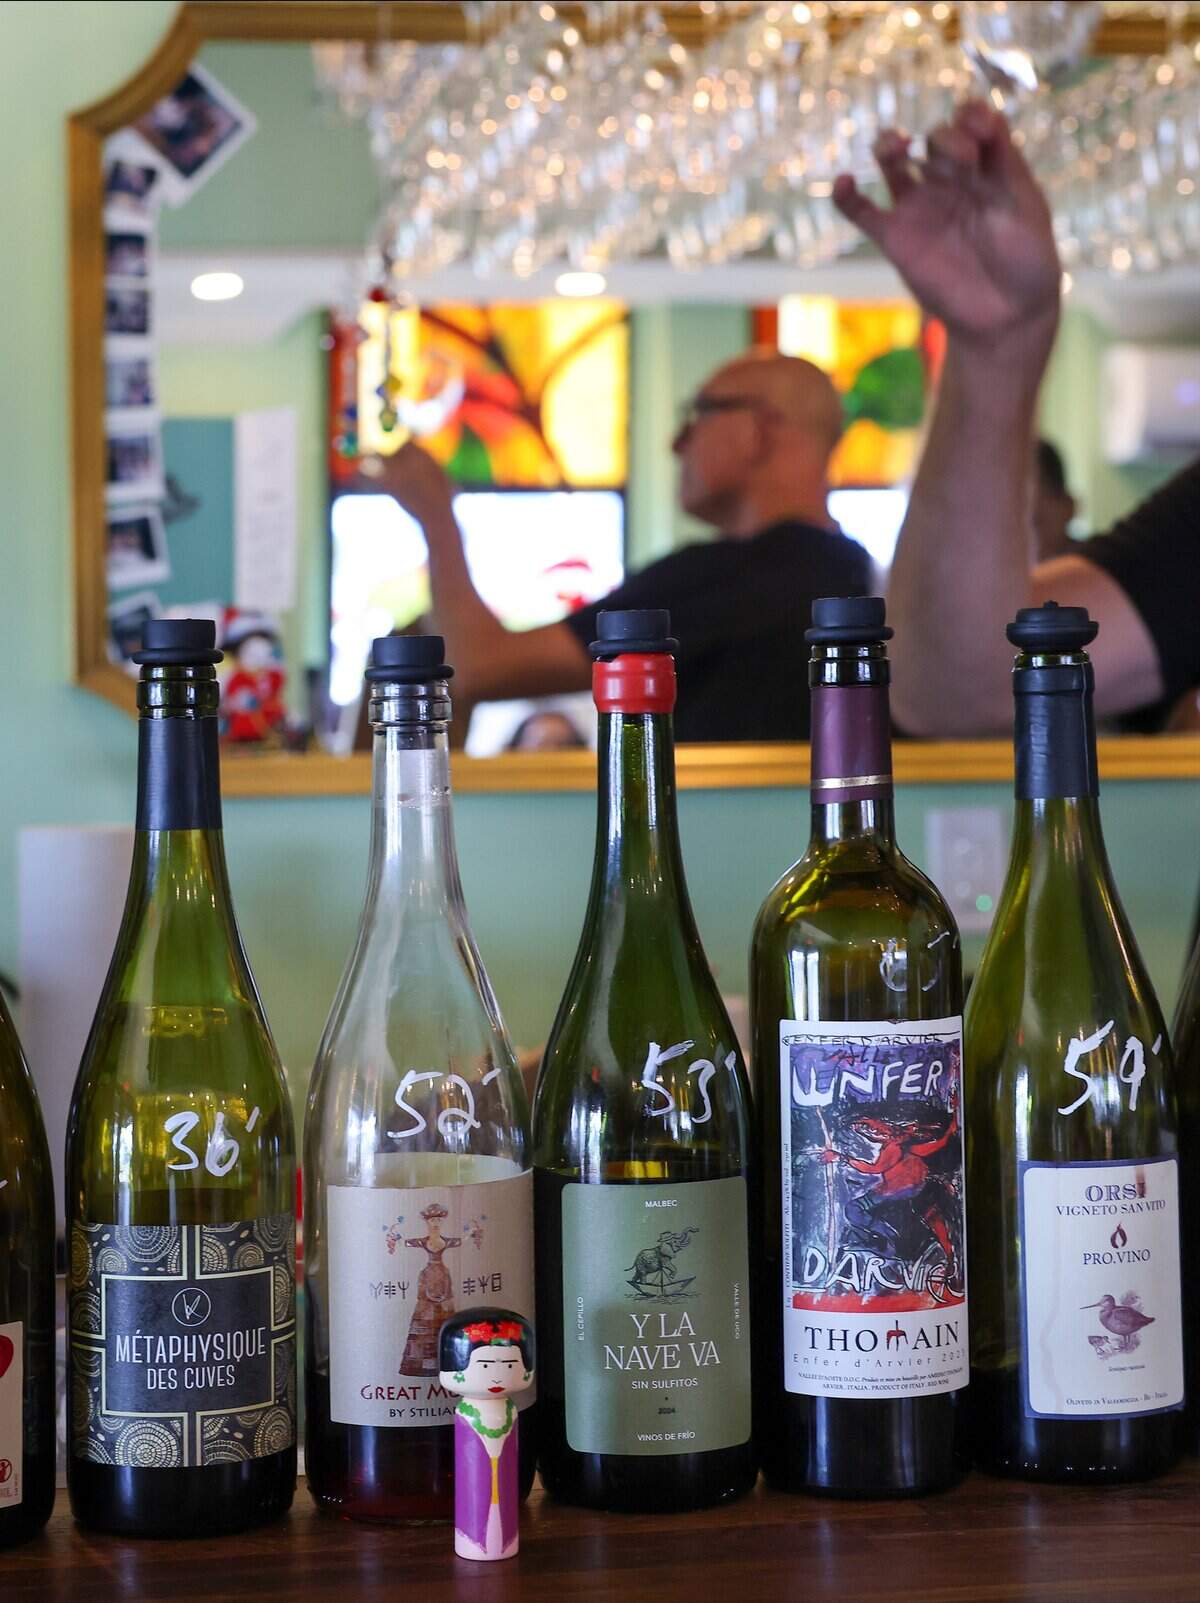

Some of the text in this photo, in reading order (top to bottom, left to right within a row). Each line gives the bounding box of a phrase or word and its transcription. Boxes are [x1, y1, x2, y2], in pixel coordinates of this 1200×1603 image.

[1085, 1183, 1146, 1202] ORSI
[645, 1199, 678, 1208] MALBEC
[1056, 1199, 1166, 1216] VIGNETO SAN VITO
[1083, 1249, 1151, 1265] PRO.VINO
[629, 1311, 697, 1339] Y LA
[115, 1327, 267, 1364] MÉTAPHYSIQUE
[603, 1340, 721, 1370] NAVE VA
[793, 1353, 840, 1367] Enfer
[147, 1365, 235, 1390] DES CUVES
[631, 1378, 698, 1390] SIN SULFITOS
[360, 1384, 421, 1400] GREAT
[389, 1408, 405, 1418] BY
[664, 1433, 676, 1441] DE
